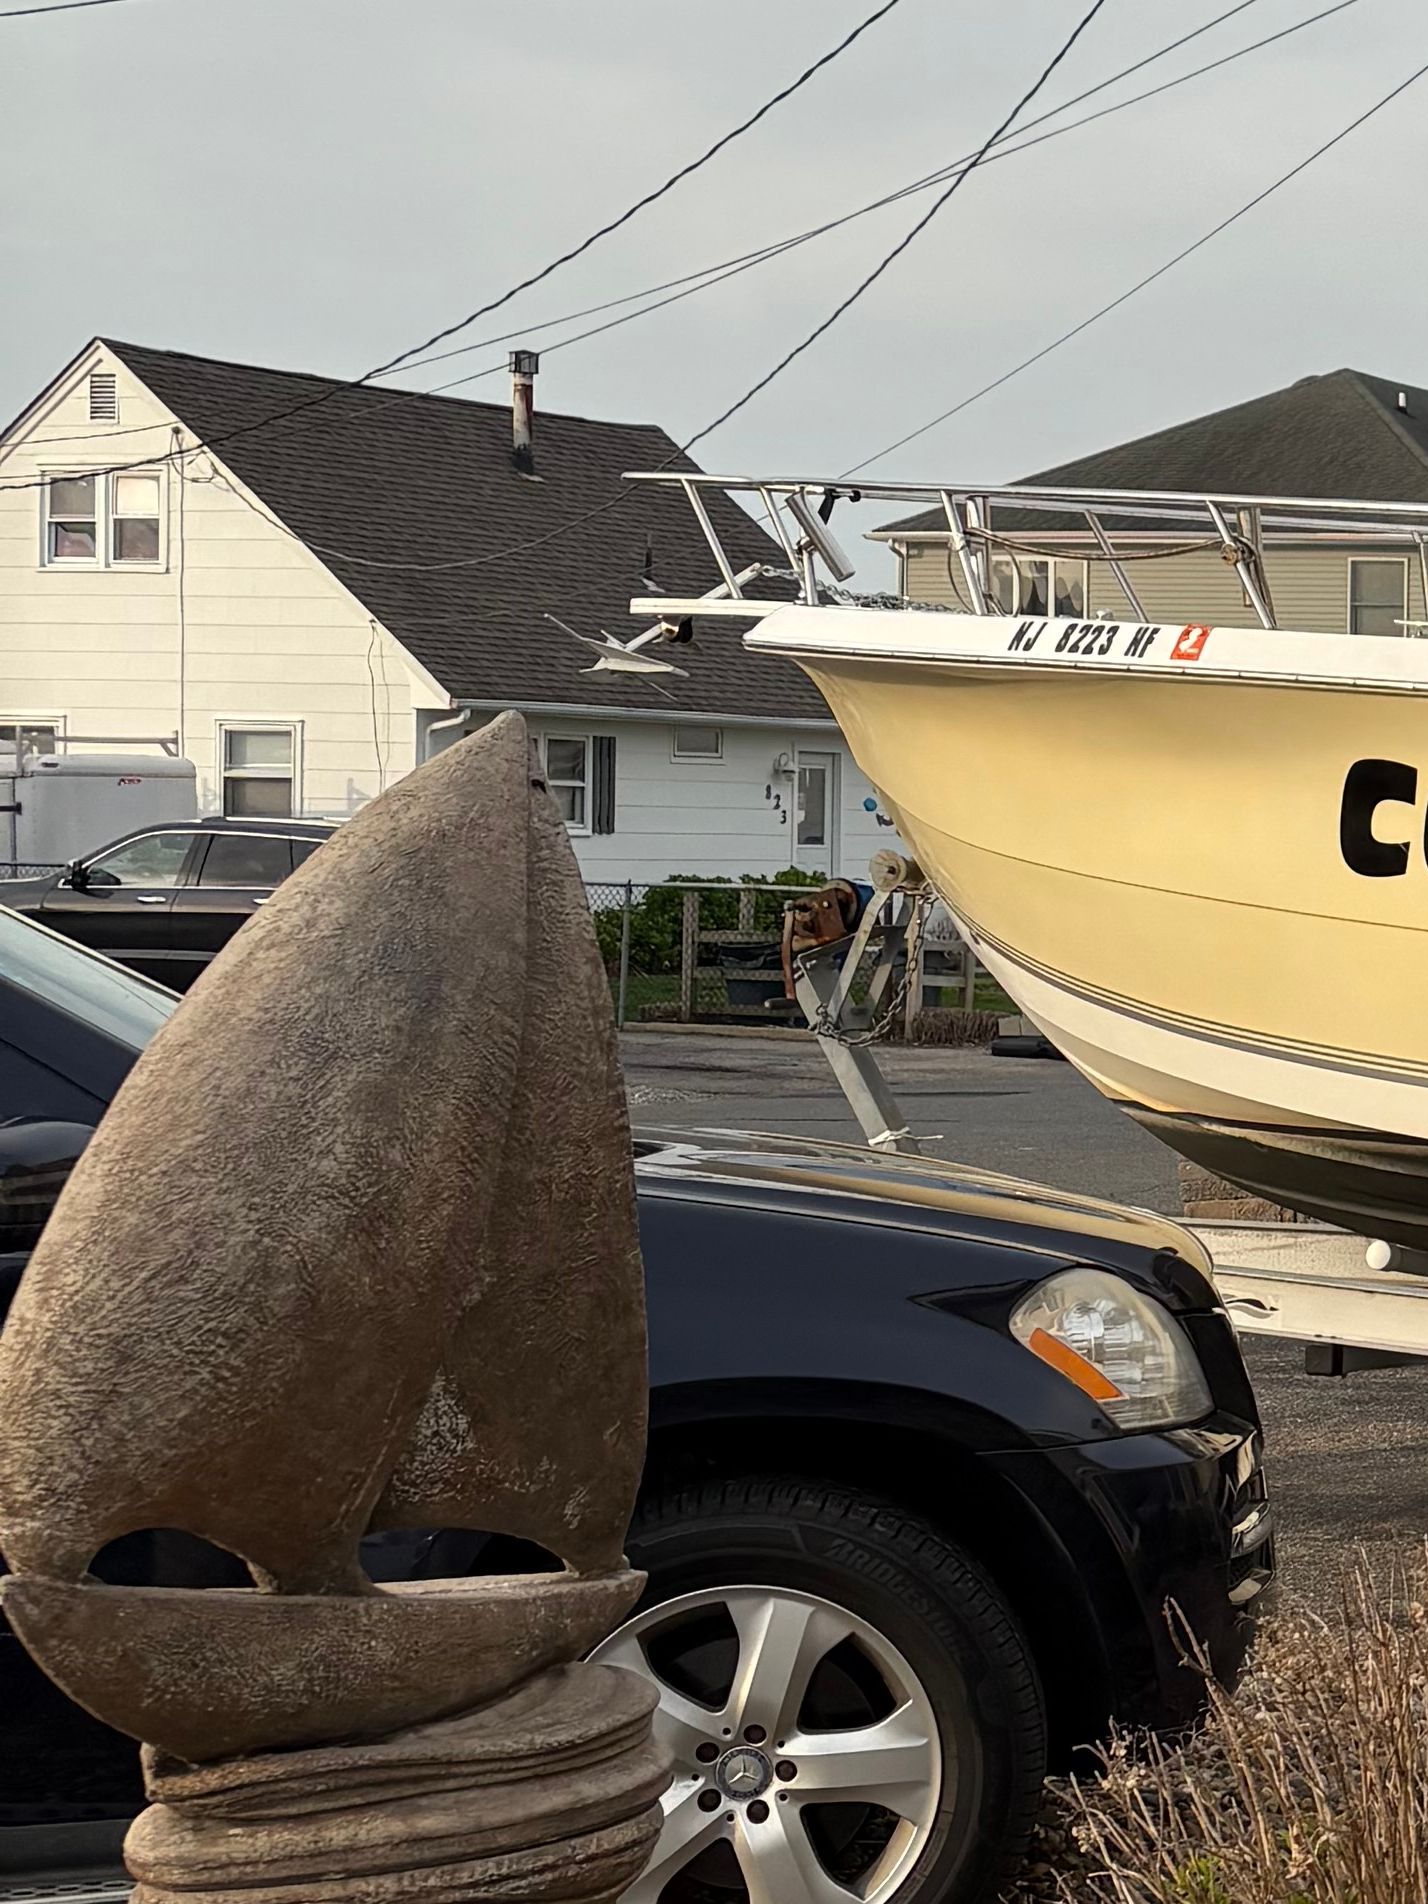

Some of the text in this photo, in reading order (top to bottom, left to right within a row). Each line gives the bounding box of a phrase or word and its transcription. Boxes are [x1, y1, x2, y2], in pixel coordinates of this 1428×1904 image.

[1008, 621, 1161, 658] NJ 8223 HF
